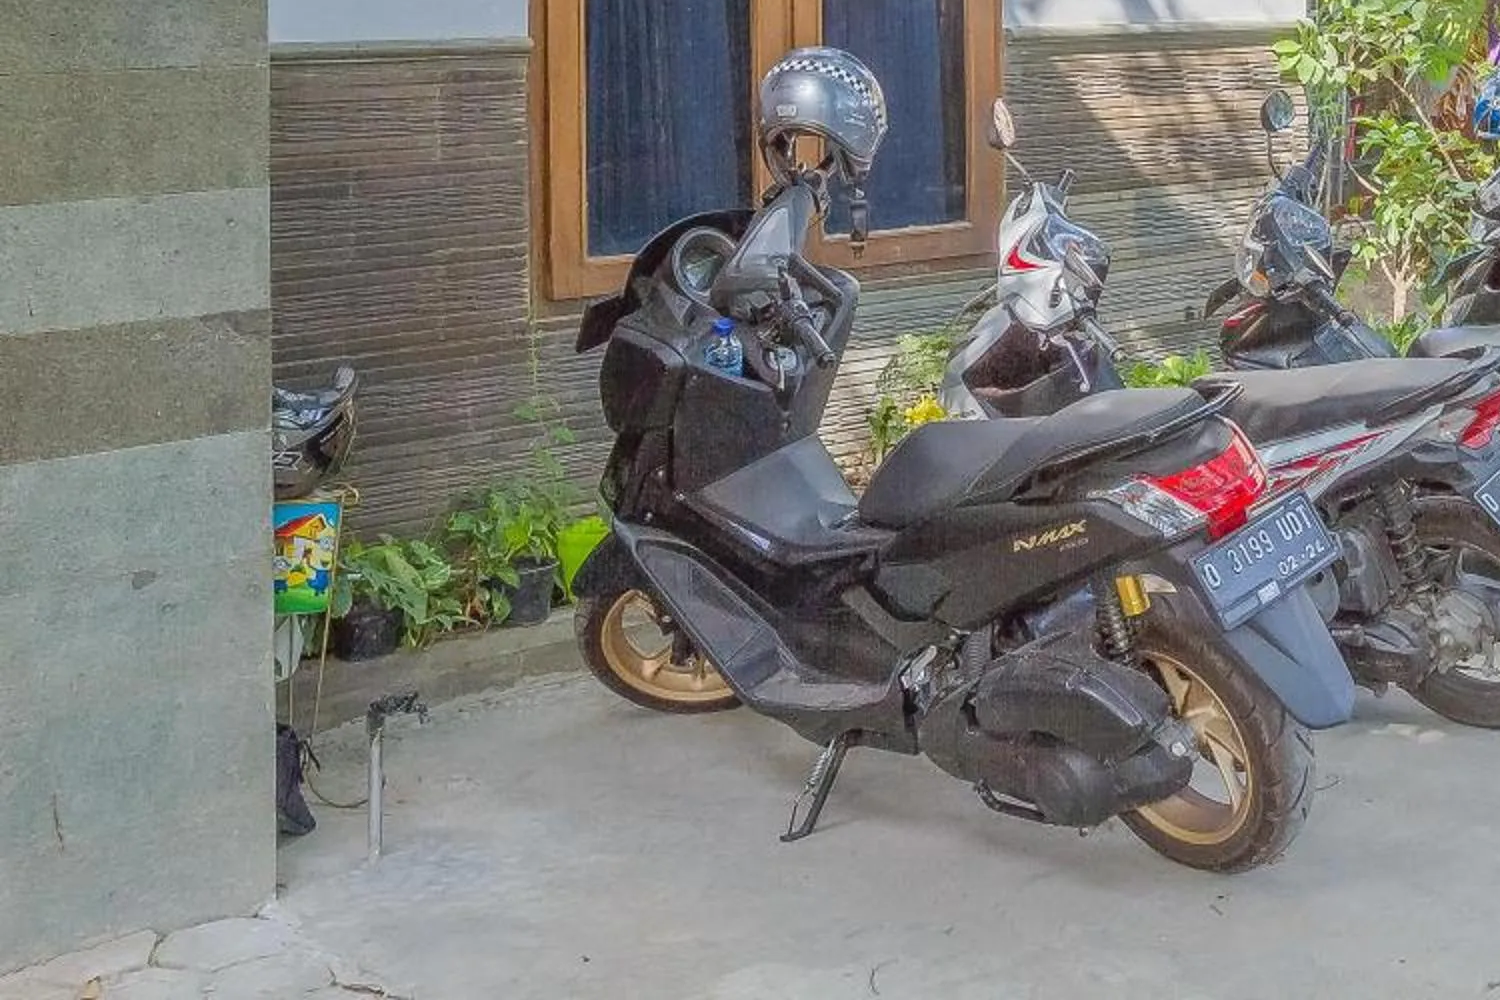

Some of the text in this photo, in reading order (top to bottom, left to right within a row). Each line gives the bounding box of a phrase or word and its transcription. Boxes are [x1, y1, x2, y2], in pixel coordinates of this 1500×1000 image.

[1480, 492, 1499, 513] D
[1227, 528, 1275, 575] 3199
[1275, 504, 1312, 541] UDT
